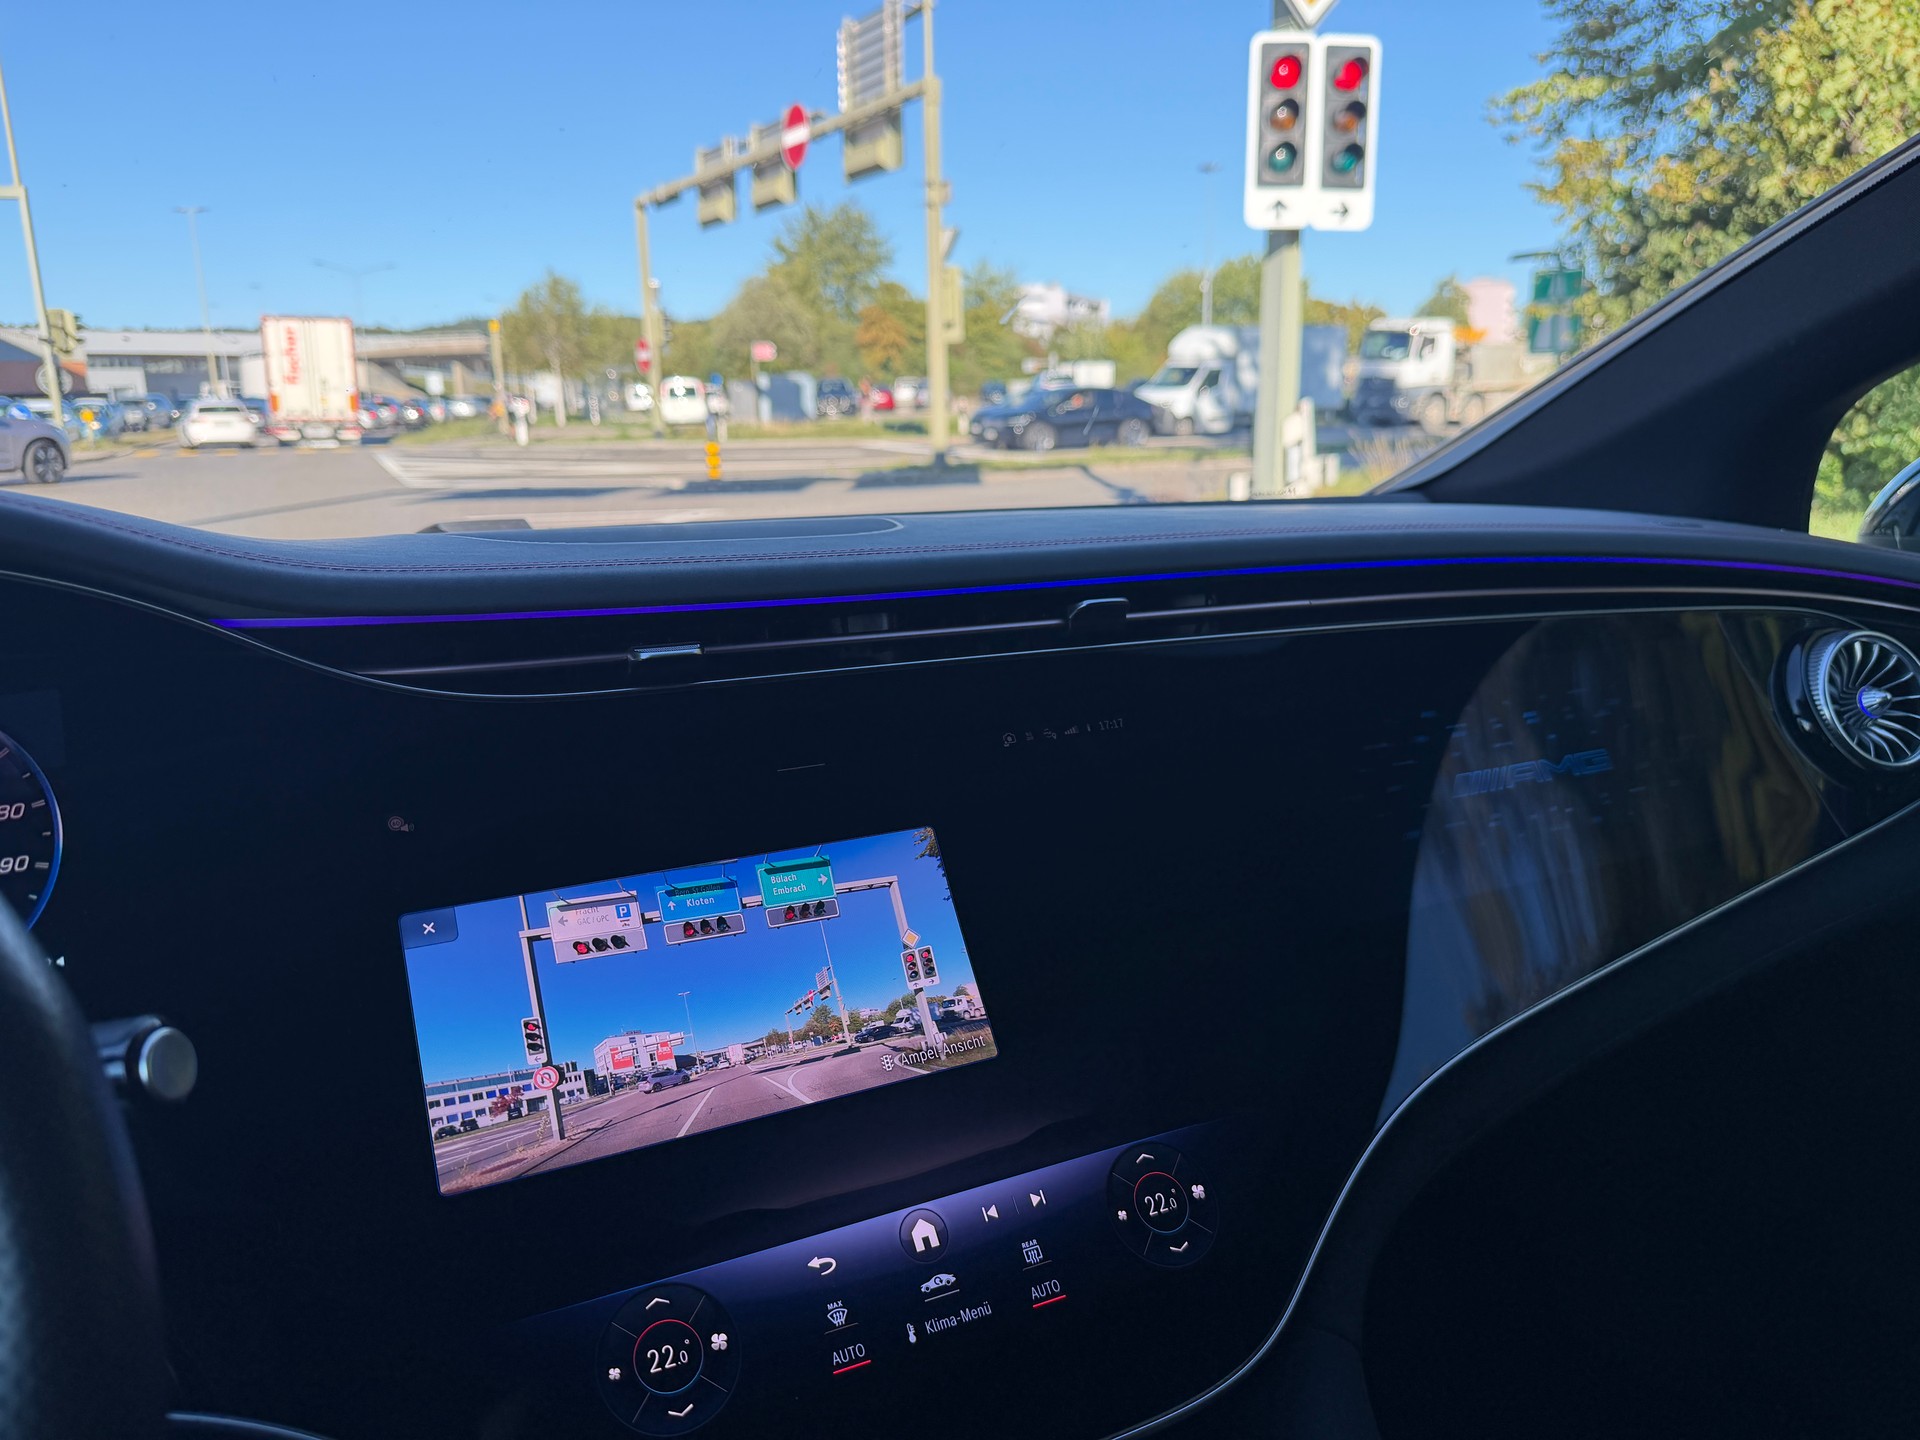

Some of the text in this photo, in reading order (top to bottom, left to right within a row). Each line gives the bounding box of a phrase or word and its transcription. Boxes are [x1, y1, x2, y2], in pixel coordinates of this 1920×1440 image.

[0, 854, 30, 874] 90
[770, 873, 797, 884] Bülach
[772, 883, 807, 896] Embrach
[686, 897, 715, 907] Kloten
[900, 1035, 986, 1065] Ampel-Ansicht
[1021, 1239, 1038, 1249] REAR
[1031, 1279, 1061, 1301] AUTO
[827, 1300, 843, 1310] MAX
[924, 1301, 993, 1334] Klima-Menü
[832, 1343, 866, 1366] AUTO
